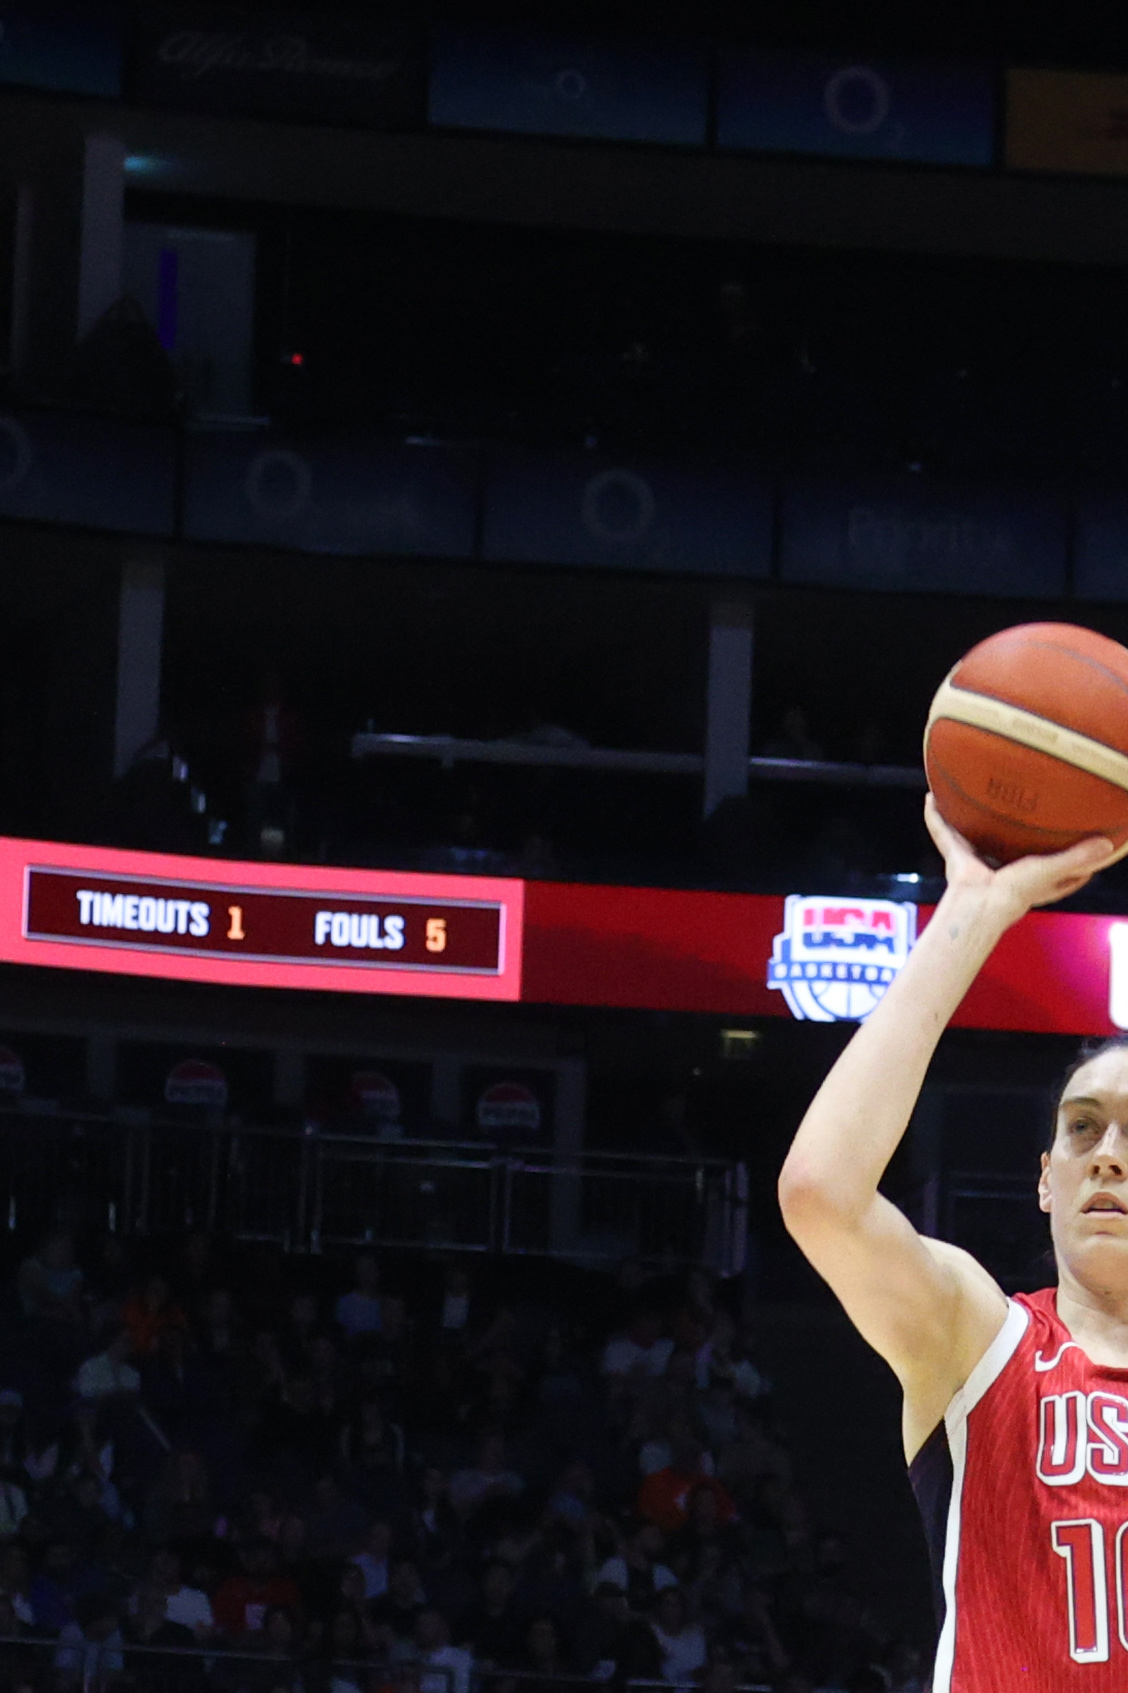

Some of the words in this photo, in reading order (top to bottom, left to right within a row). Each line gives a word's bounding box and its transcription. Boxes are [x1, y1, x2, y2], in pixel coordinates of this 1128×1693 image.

[76, 890, 210, 938] TIMEOUTS
[227, 906, 245, 941] 1
[314, 910, 405, 951] FOULS
[425, 918, 446, 953] 5
[774, 962, 895, 984] BASKETBA
